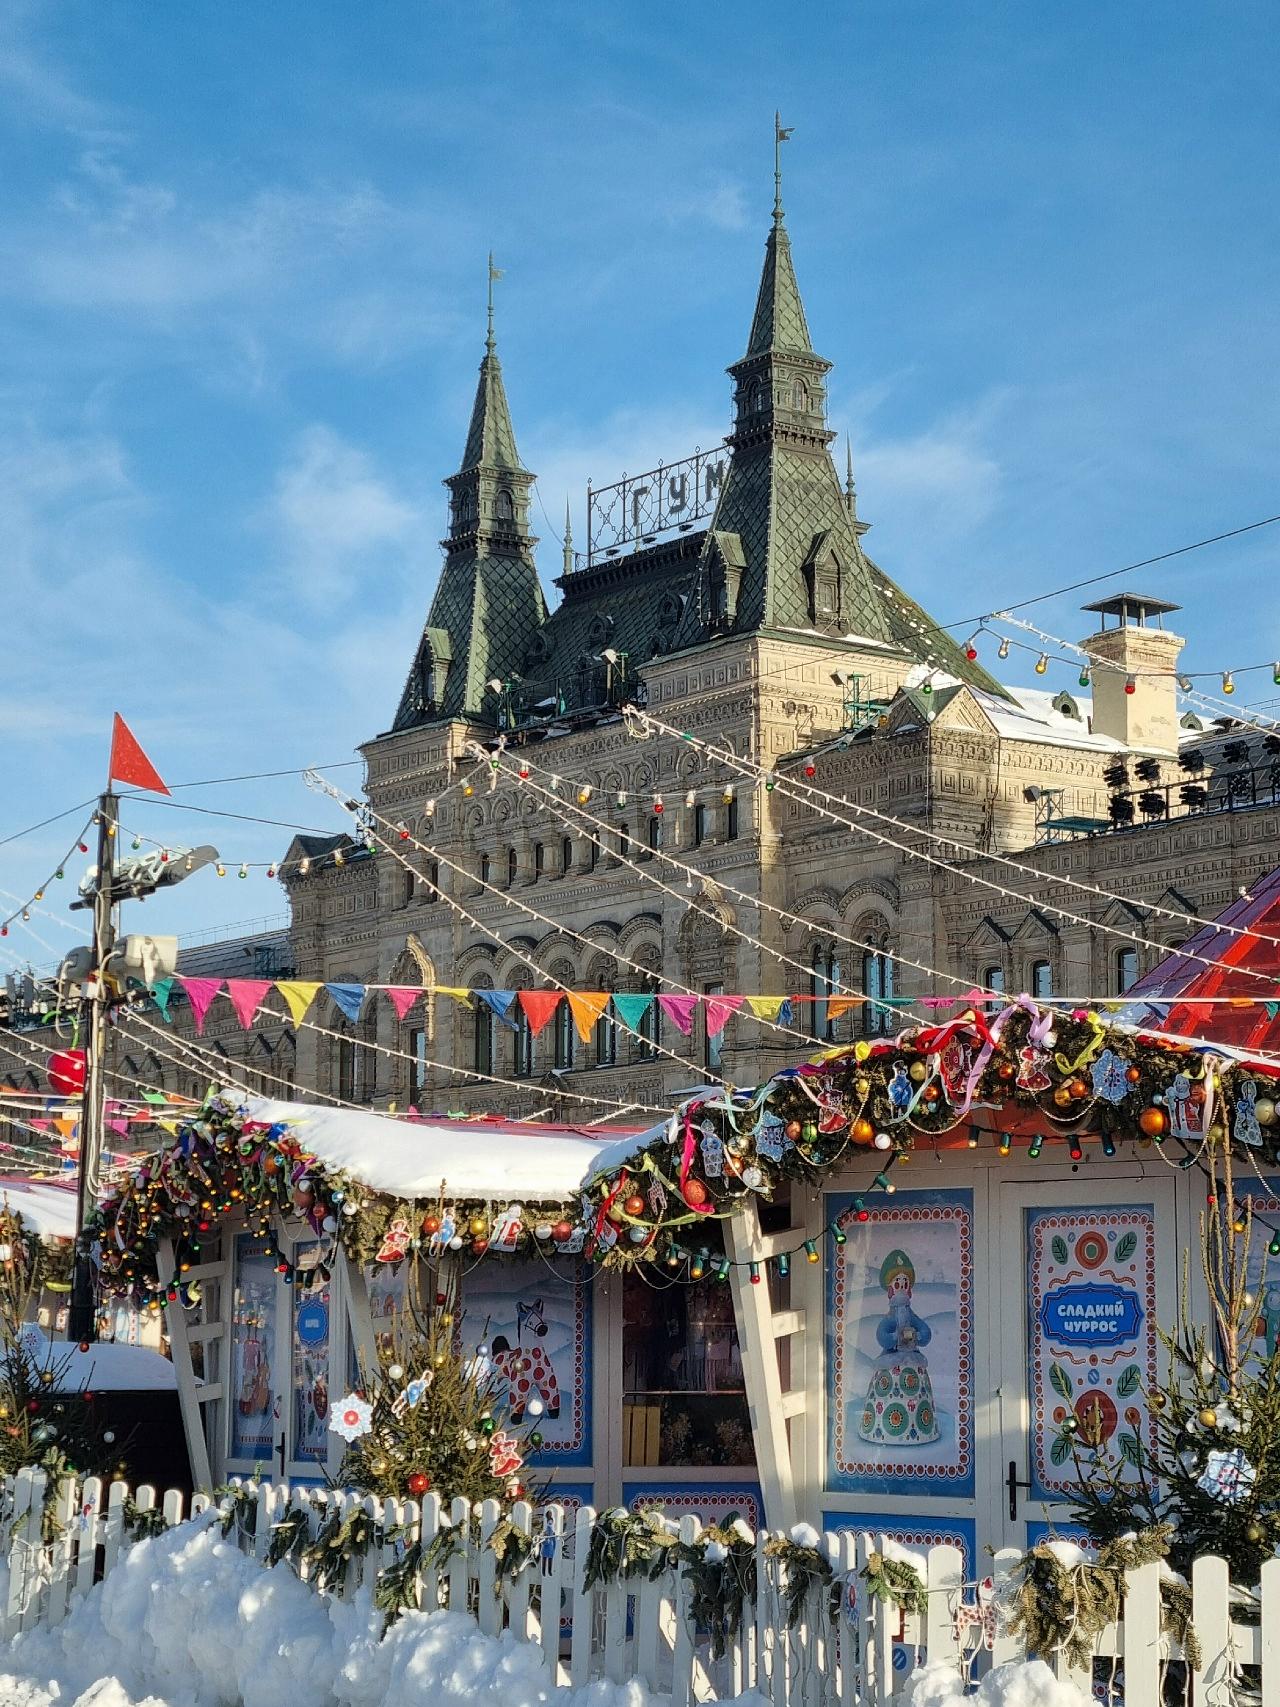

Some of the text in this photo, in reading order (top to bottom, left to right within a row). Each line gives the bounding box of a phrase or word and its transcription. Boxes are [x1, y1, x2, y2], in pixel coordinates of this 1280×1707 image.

[632, 459, 724, 528] ГУМ
[1057, 1300, 1125, 1319] СЛАДКИЙ
[1064, 1320, 1118, 1333] ЧУРРОС
